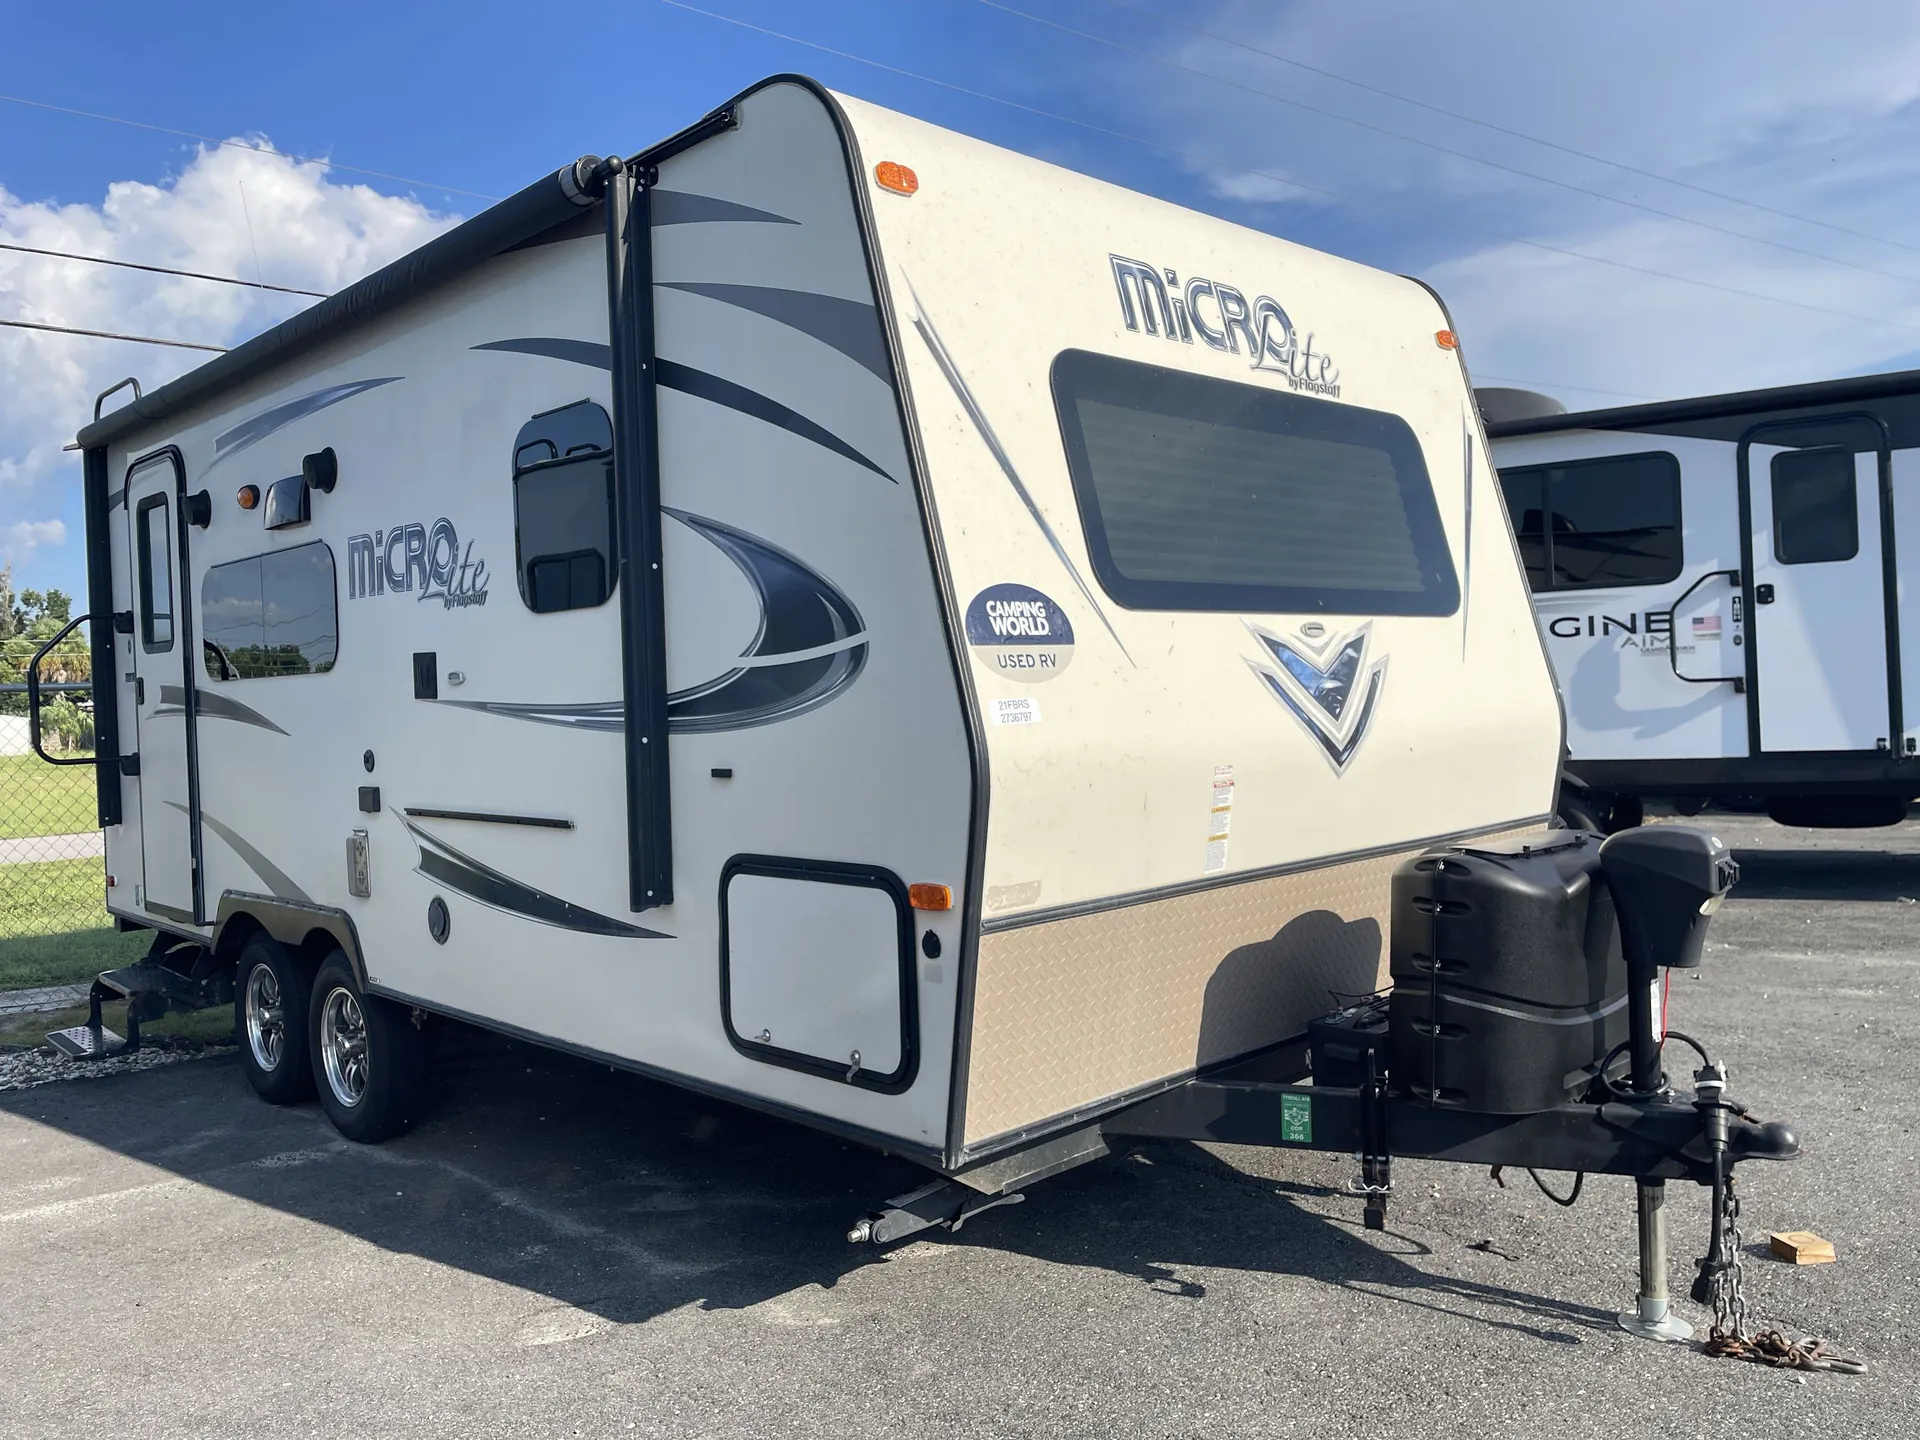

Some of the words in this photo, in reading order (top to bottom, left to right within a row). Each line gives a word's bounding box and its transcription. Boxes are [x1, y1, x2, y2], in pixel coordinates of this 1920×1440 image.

[1288, 375, 1300, 390] by
[1299, 376, 1341, 398] Flagstaff
[451, 589, 488, 608] Flagstaff
[985, 600, 1046, 617] CAMPING
[997, 654, 1036, 669] USED
[1039, 653, 1056, 668] RV
[998, 699, 1030, 711] 21FBRS
[1000, 711, 1032, 724] 2736797
[1289, 1132, 1304, 1140] 366
